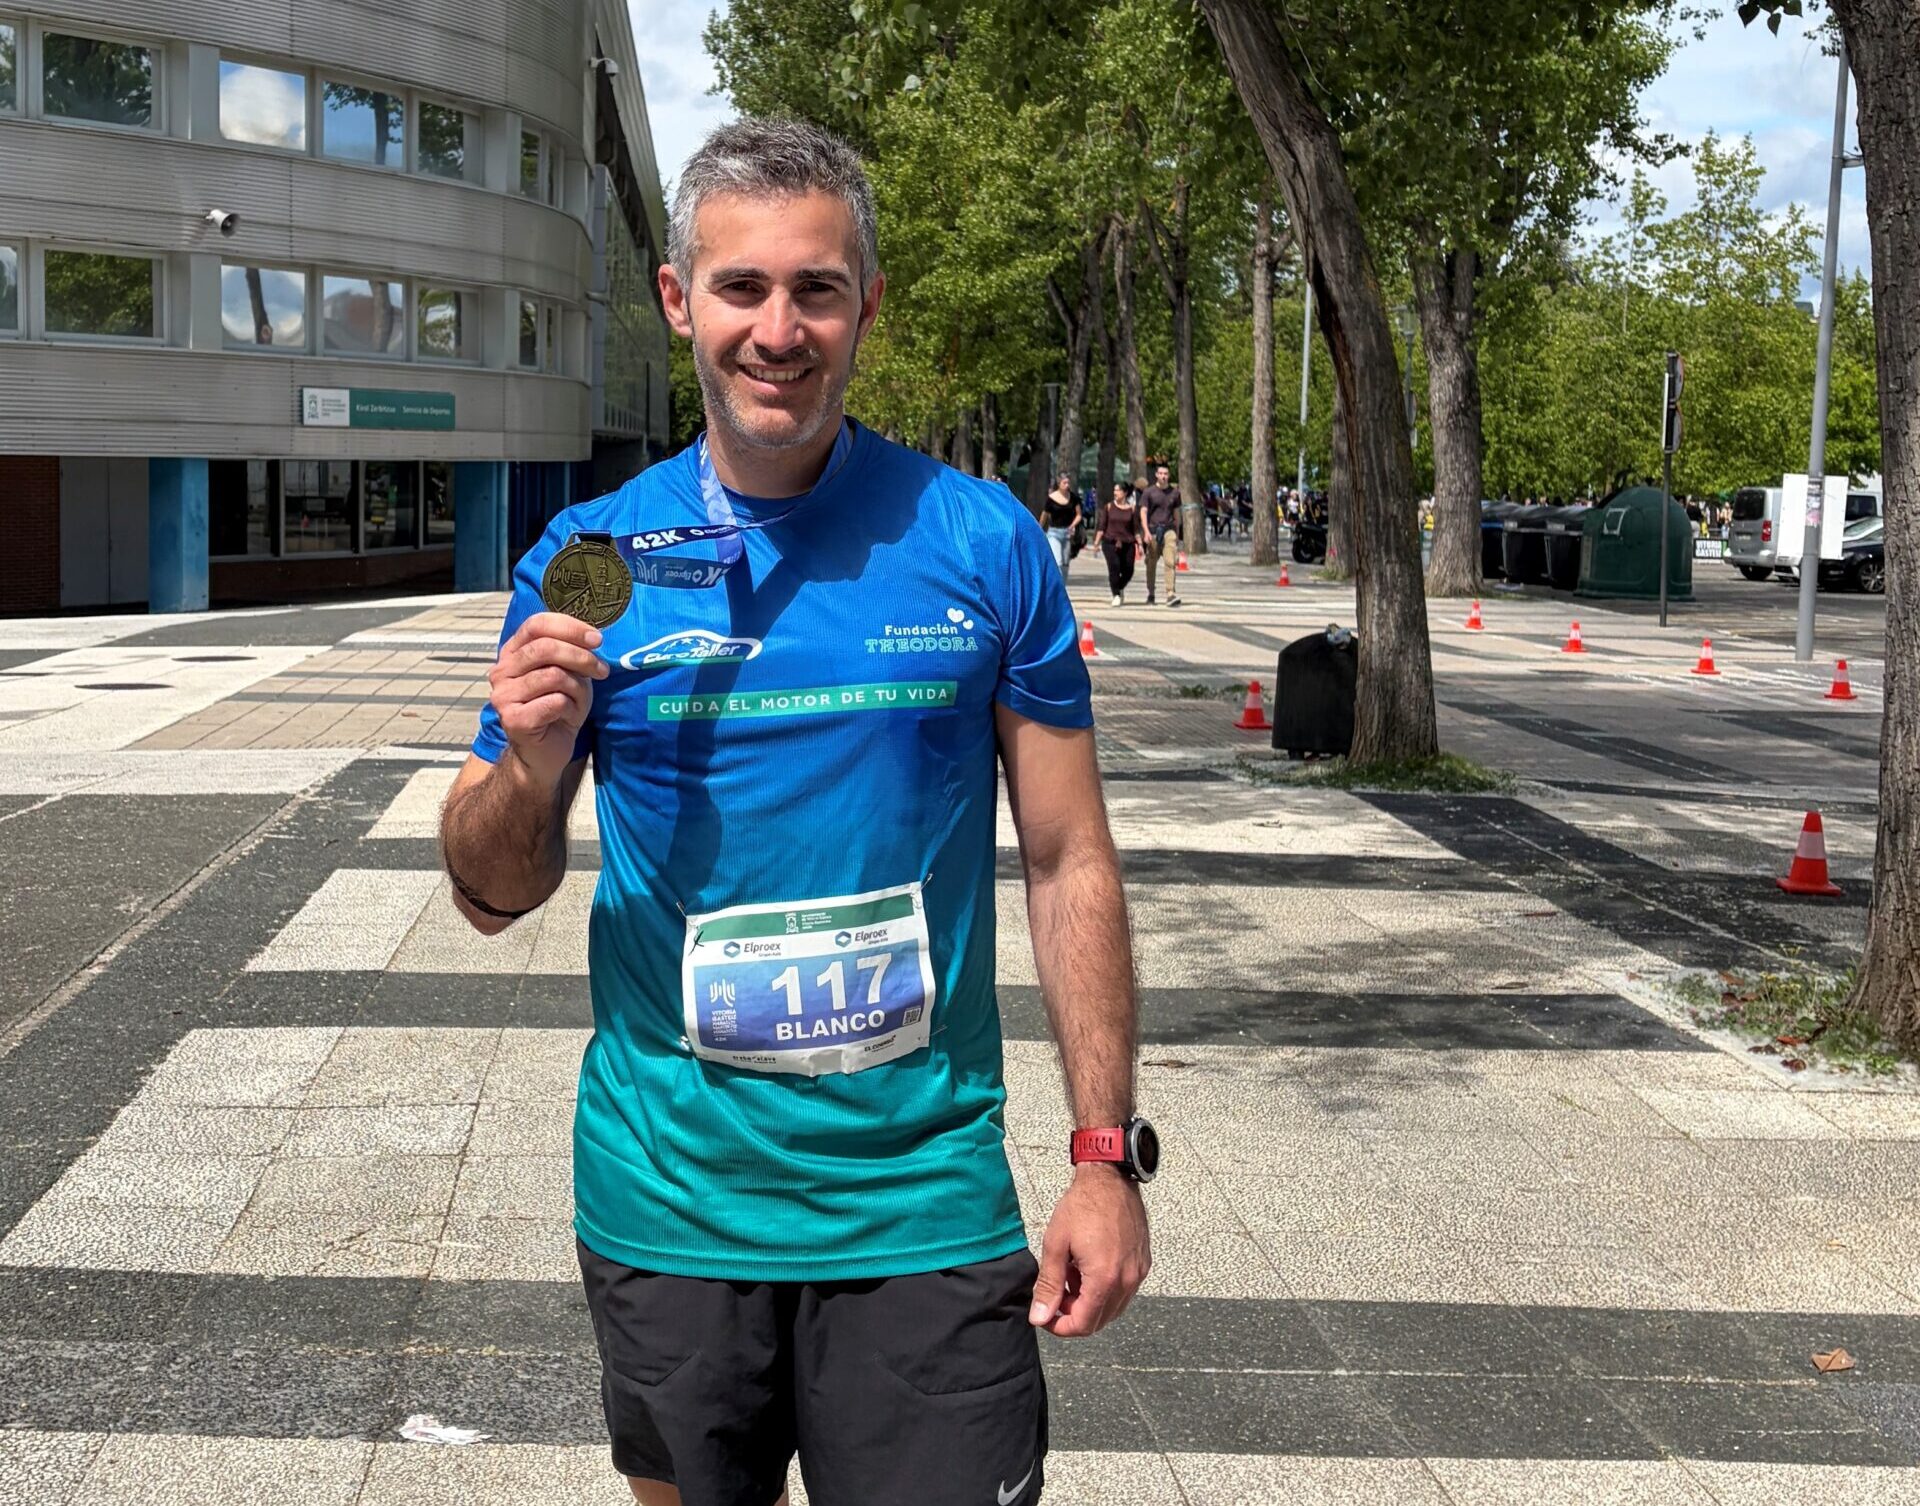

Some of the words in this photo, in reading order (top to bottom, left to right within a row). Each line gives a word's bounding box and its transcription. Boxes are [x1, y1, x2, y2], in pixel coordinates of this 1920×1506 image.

[632, 529, 686, 550] 42K
[884, 623, 959, 636] Fundación
[864, 636, 979, 653] THEODORA
[659, 701, 720, 714] CUIDA
[729, 699, 751, 711] EL
[760, 694, 831, 710] MOTOR
[841, 691, 865, 705] DE
[875, 689, 897, 701] TU
[907, 688, 947, 700] VIDA
[855, 928, 888, 942] Elproex
[744, 942, 781, 954] Elproex
[771, 952, 892, 1016] 117
[775, 1009, 886, 1041] BLANCO
